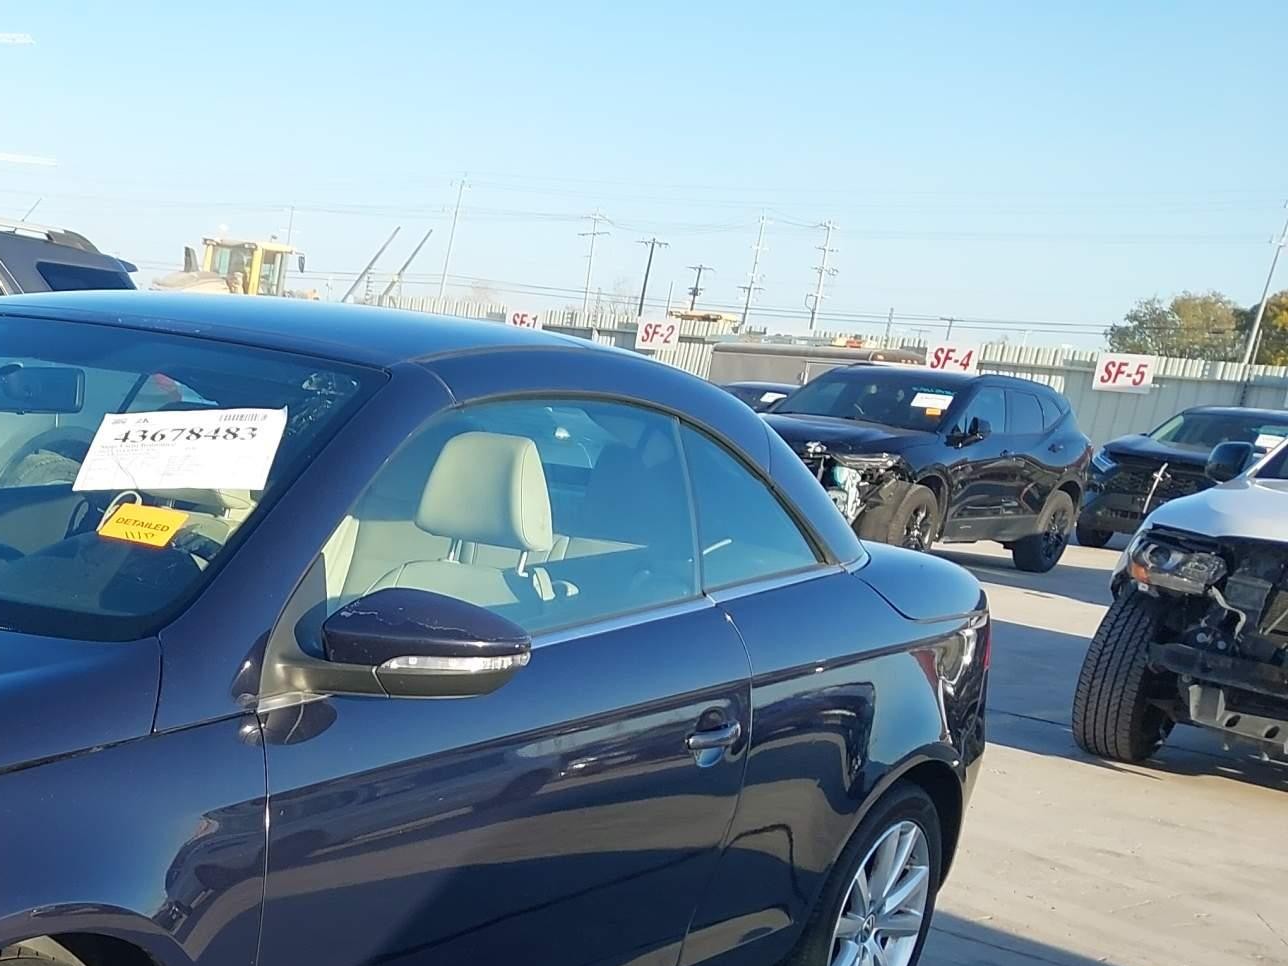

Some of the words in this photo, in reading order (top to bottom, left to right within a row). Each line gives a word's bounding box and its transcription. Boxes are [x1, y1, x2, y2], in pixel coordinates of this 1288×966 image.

[641, 322, 675, 344] SF-2
[930, 347, 974, 371] SF-4
[1100, 360, 1149, 386] SF-5
[115, 426, 258, 443] 43678483
[115, 517, 170, 532] DETAILED
